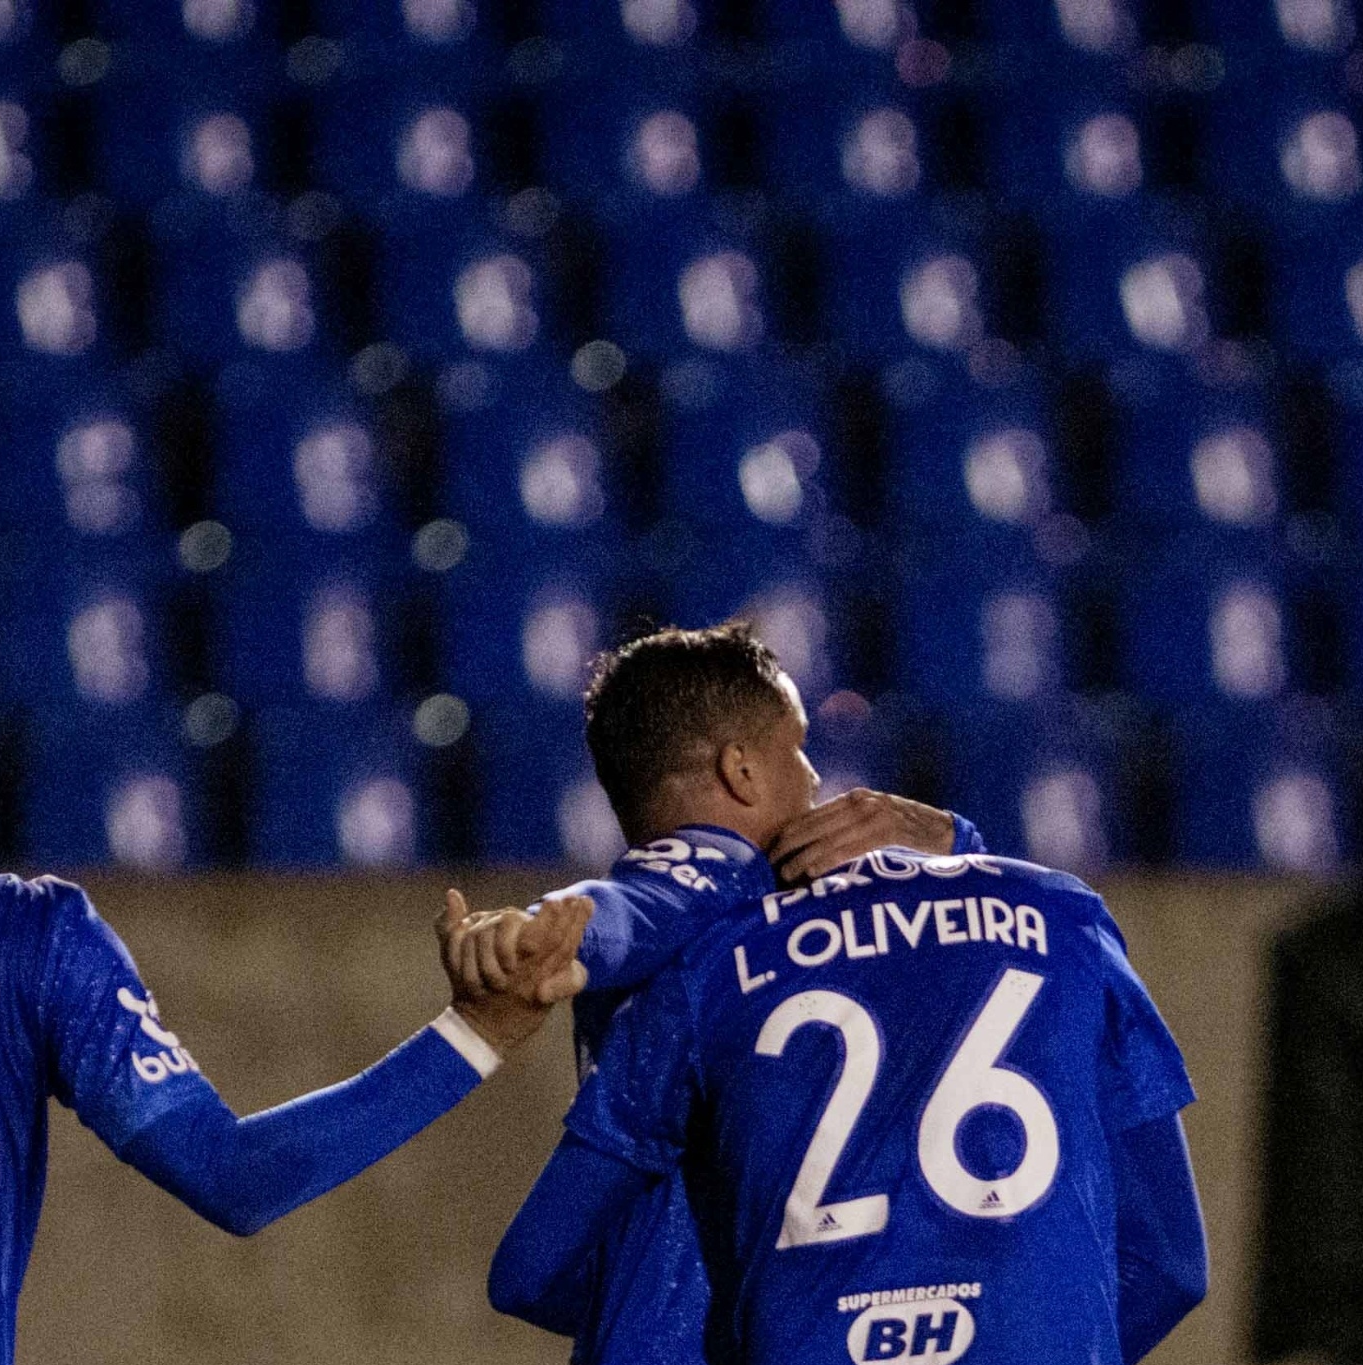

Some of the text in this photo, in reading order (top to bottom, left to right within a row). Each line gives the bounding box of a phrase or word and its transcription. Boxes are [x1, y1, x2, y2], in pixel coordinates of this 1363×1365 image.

[732, 896, 1048, 995] L. OLIVEIRA
[753, 967, 1060, 1251] 26
[836, 1282, 983, 1312] SUPERMERCADOS
[862, 1310, 960, 1362] BH
